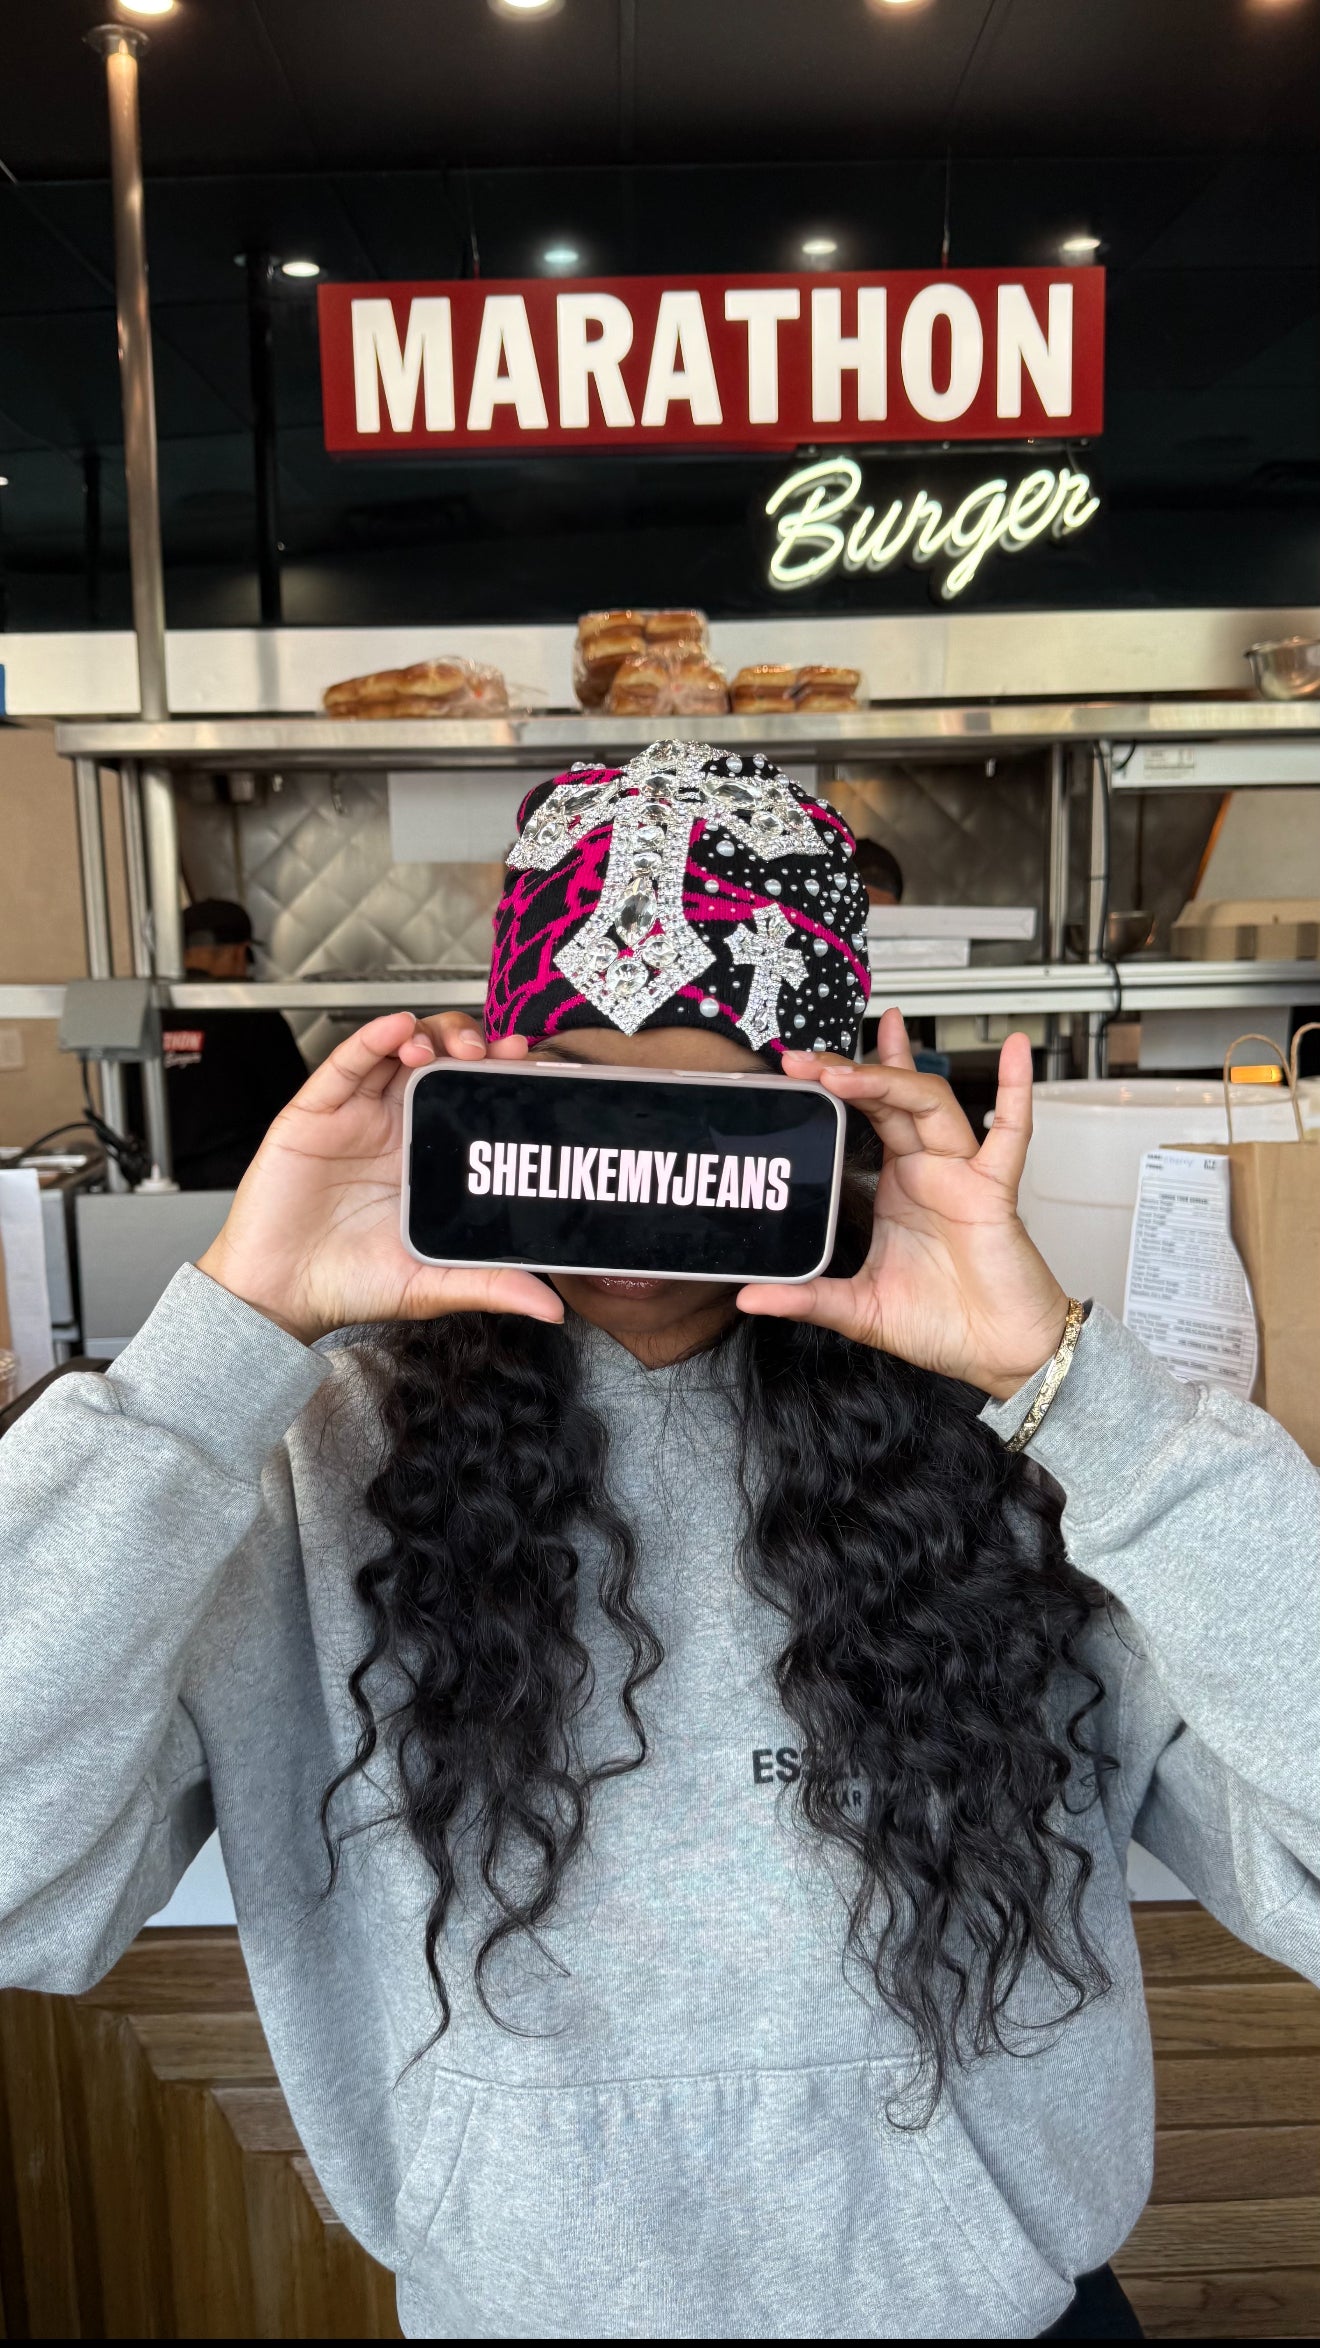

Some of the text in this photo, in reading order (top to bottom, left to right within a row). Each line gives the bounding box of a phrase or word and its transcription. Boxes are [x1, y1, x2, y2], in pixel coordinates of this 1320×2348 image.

[350, 283, 1075, 434] MARATHON
[765, 455, 1101, 596] Burger
[467, 1140, 791, 1211] SHELIKEMYJEANS
